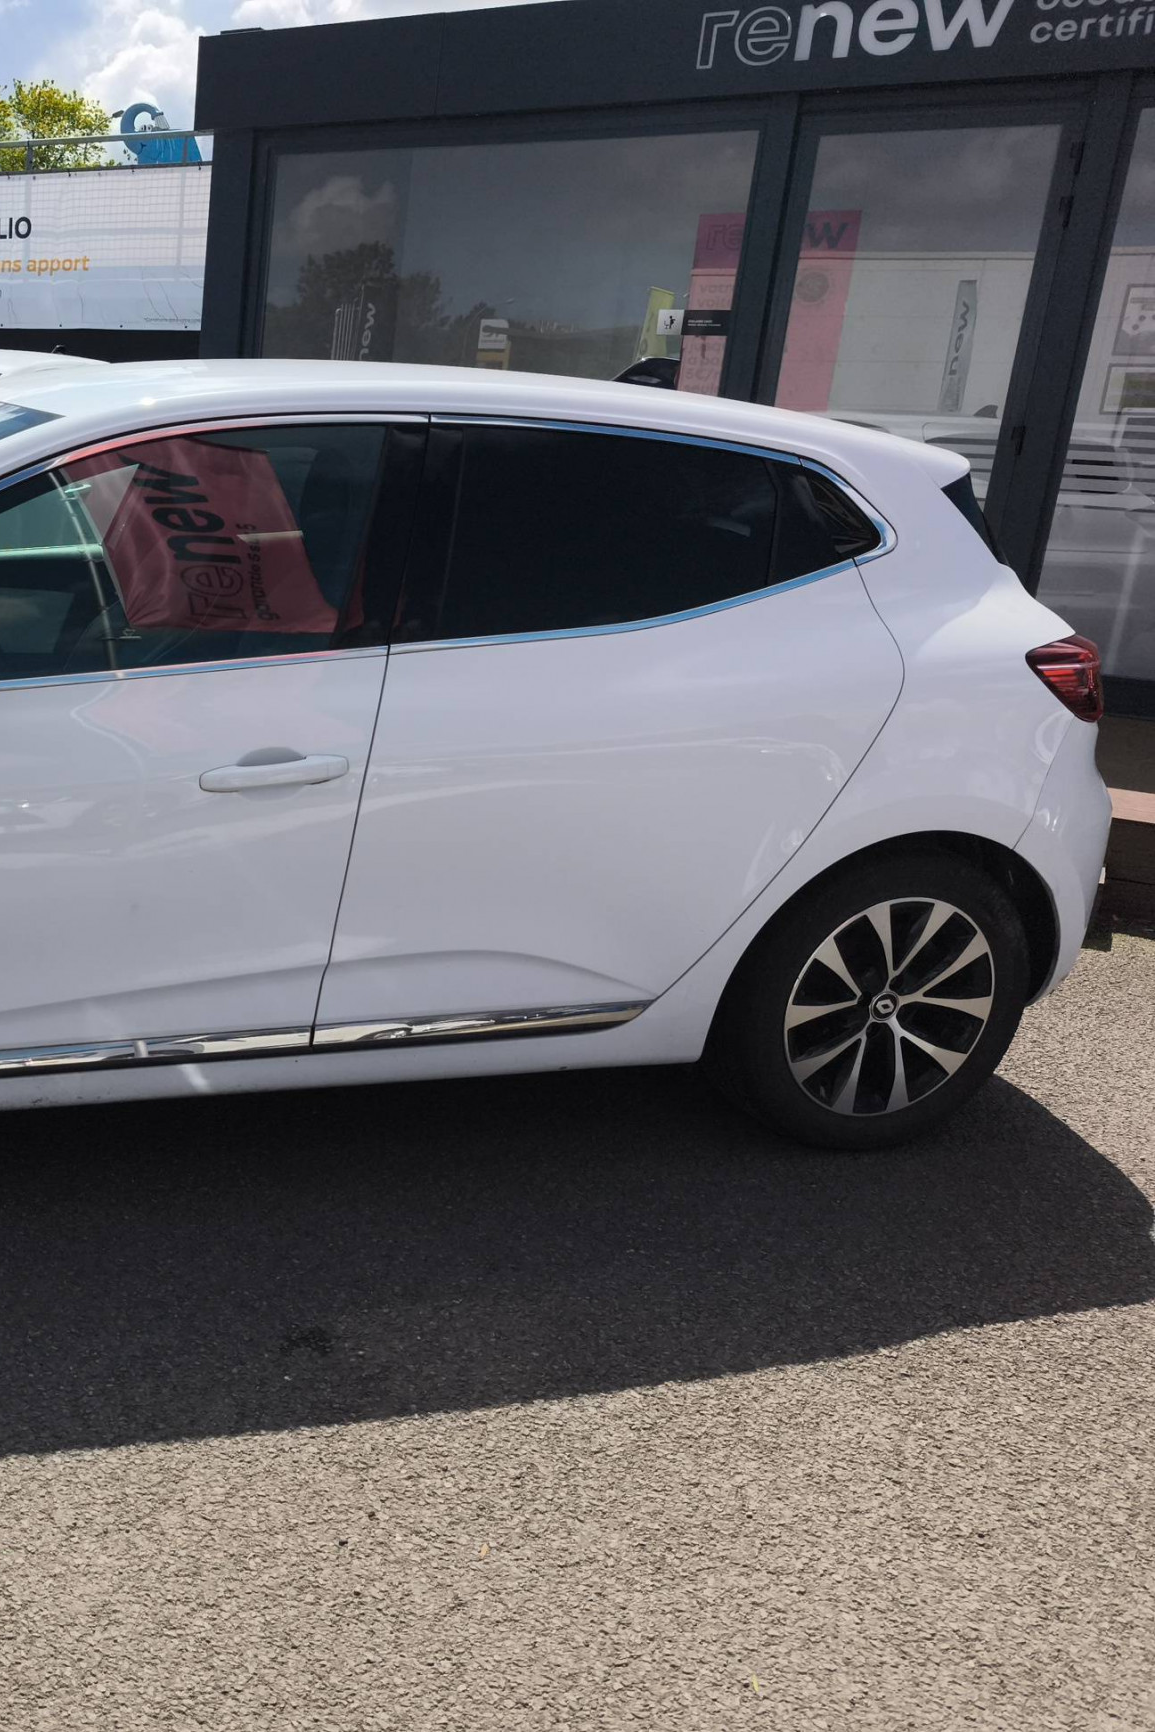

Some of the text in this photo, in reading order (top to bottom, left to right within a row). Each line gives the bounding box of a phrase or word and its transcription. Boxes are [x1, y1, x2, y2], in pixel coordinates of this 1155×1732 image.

[696, 0, 1014, 70] renew
[26, 255, 91, 276] apport
[117, 454, 247, 620] renew
